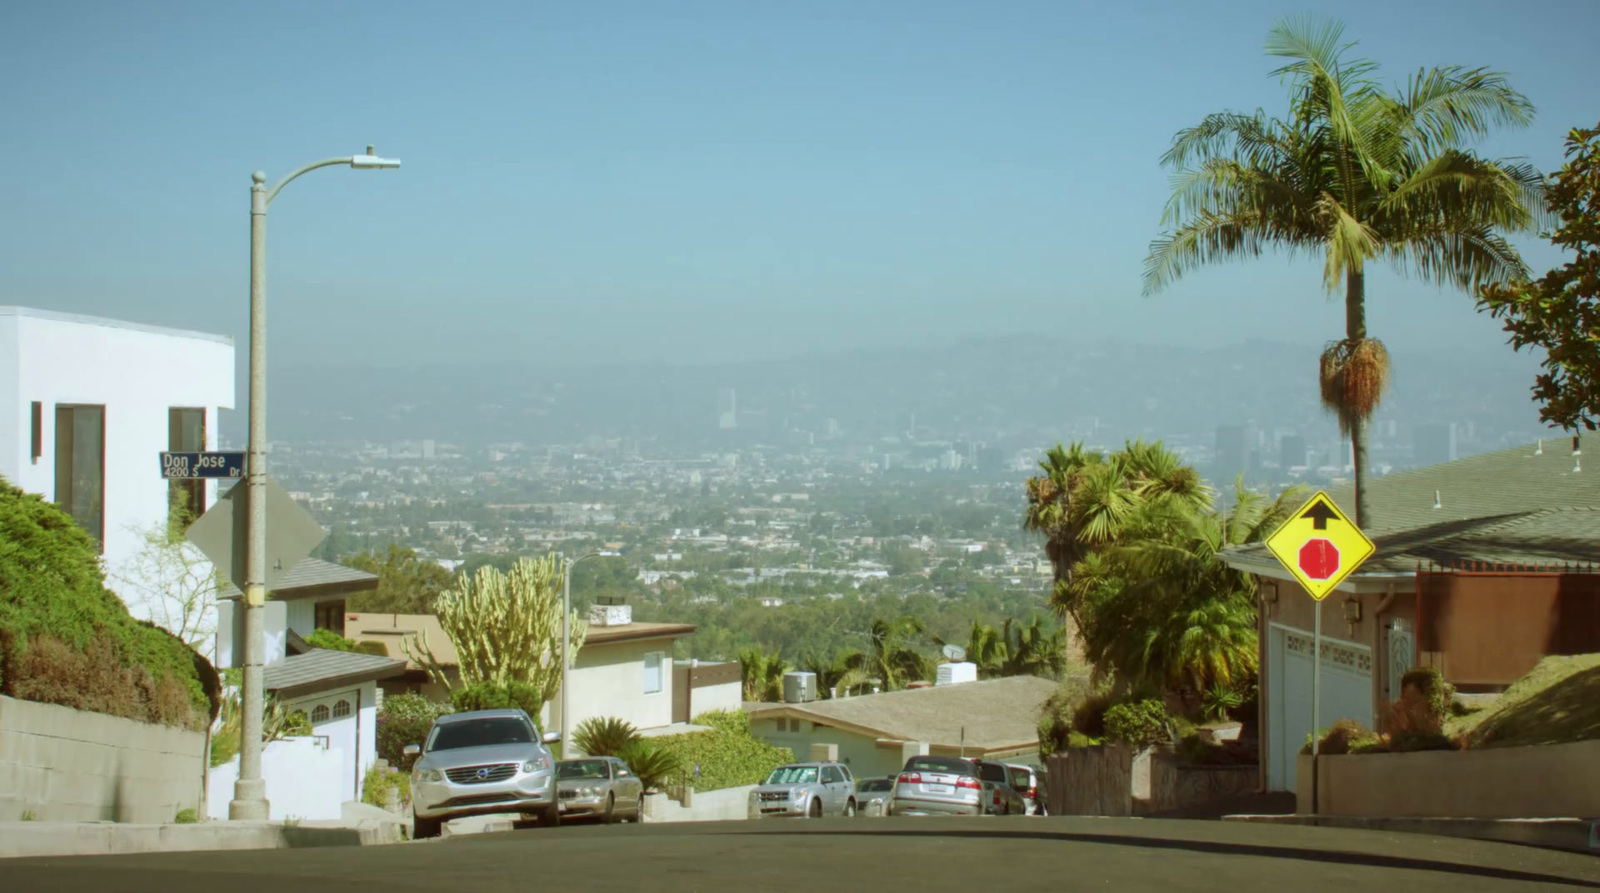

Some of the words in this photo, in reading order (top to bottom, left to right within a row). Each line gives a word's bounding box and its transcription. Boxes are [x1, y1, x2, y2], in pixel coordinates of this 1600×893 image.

[164, 454, 188, 467] Don
[194, 454, 225, 468] Jose
[164, 467, 188, 476] 4200
[192, 467, 199, 476] S
[230, 467, 240, 476] Dr
